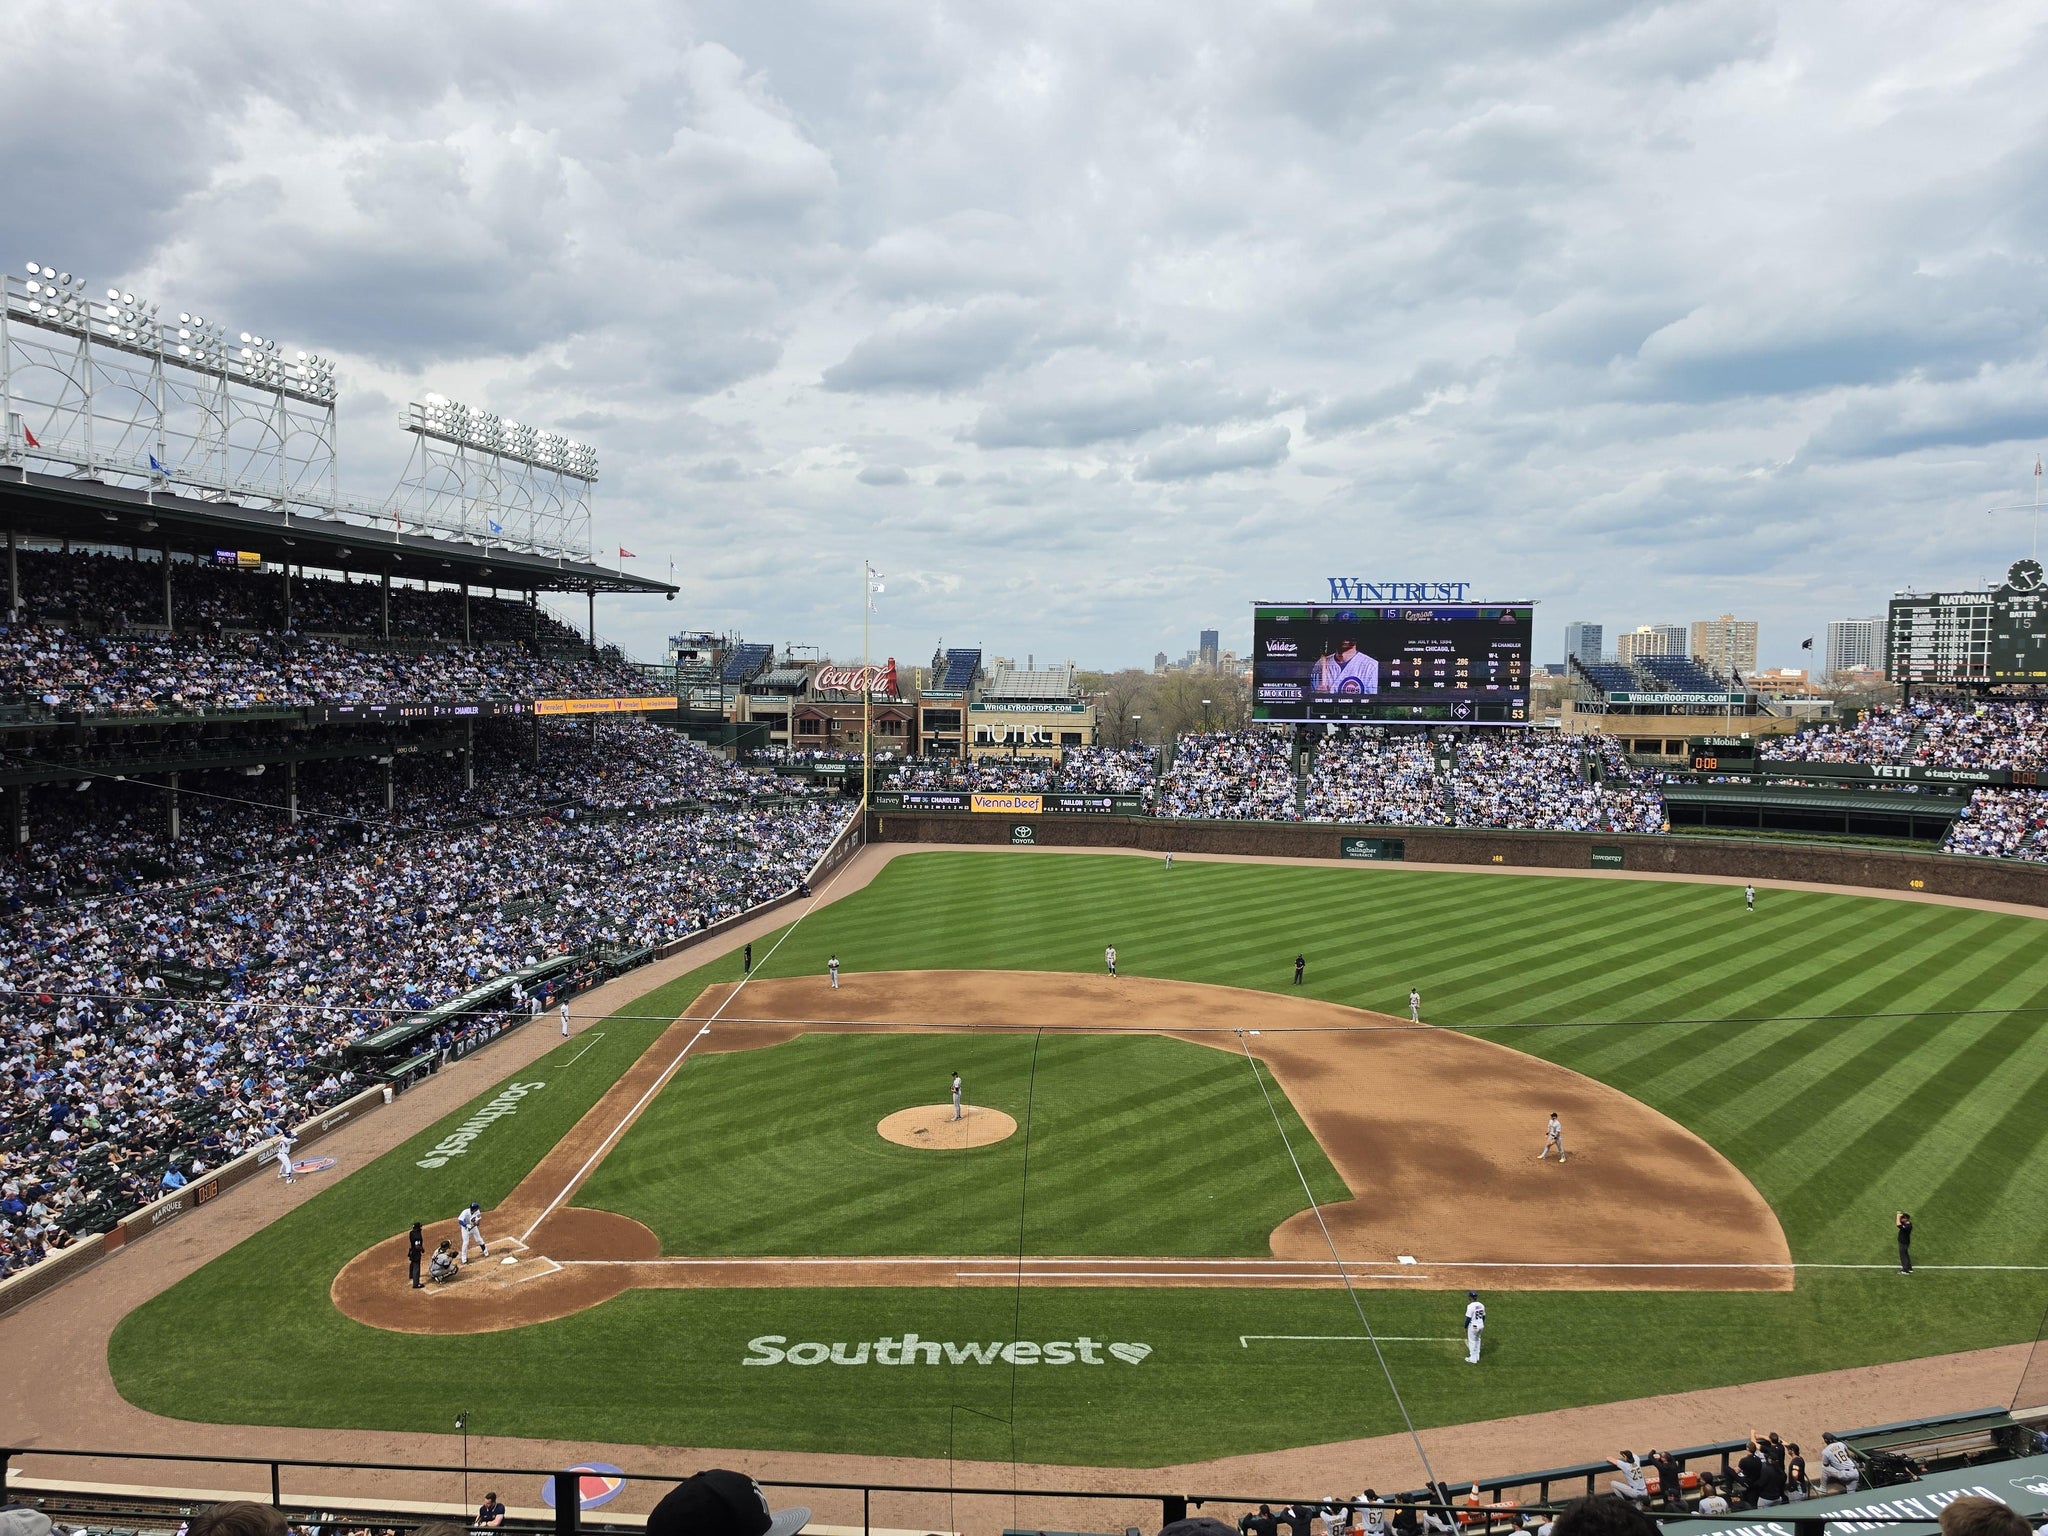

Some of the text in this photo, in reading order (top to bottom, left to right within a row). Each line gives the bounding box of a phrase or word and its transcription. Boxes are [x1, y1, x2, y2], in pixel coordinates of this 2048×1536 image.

[1327, 578, 1470, 601] WINTRUST
[1939, 594, 1994, 605] NATIONAL
[1387, 609, 1396, 618] 15
[1266, 641, 1298, 652] Valdez
[814, 665, 894, 692] Coca-Cola
[1258, 690, 1303, 698] SMOKIES
[1629, 693, 1728, 702] WRIGLEYROOFTOPS.COM
[455, 707, 479, 715] CHANDLER
[984, 704, 1072, 712] WRIGLEYROOFTOPS.COM
[1512, 709, 1524, 718] 53
[1713, 738, 1741, 746] Mobile
[1696, 758, 1717, 769] 0:08
[1871, 765, 1910, 777] YETI
[1933, 769, 1989, 780] tastytrade
[2013, 772, 2036, 784] 0:08
[876, 796, 899, 805] Harvey
[974, 796, 1040, 811] Vienna Beef
[1592, 854, 1622, 862] Invenergy
[425, 1082, 546, 1158] Southwest
[199, 1180, 217, 1204] 0:08
[152, 1201, 182, 1223] MARQUEE
[742, 1333, 1104, 1365] Southwest
[1834, 1451, 1848, 1464] 16
[1369, 1512, 1383, 1525] 67
